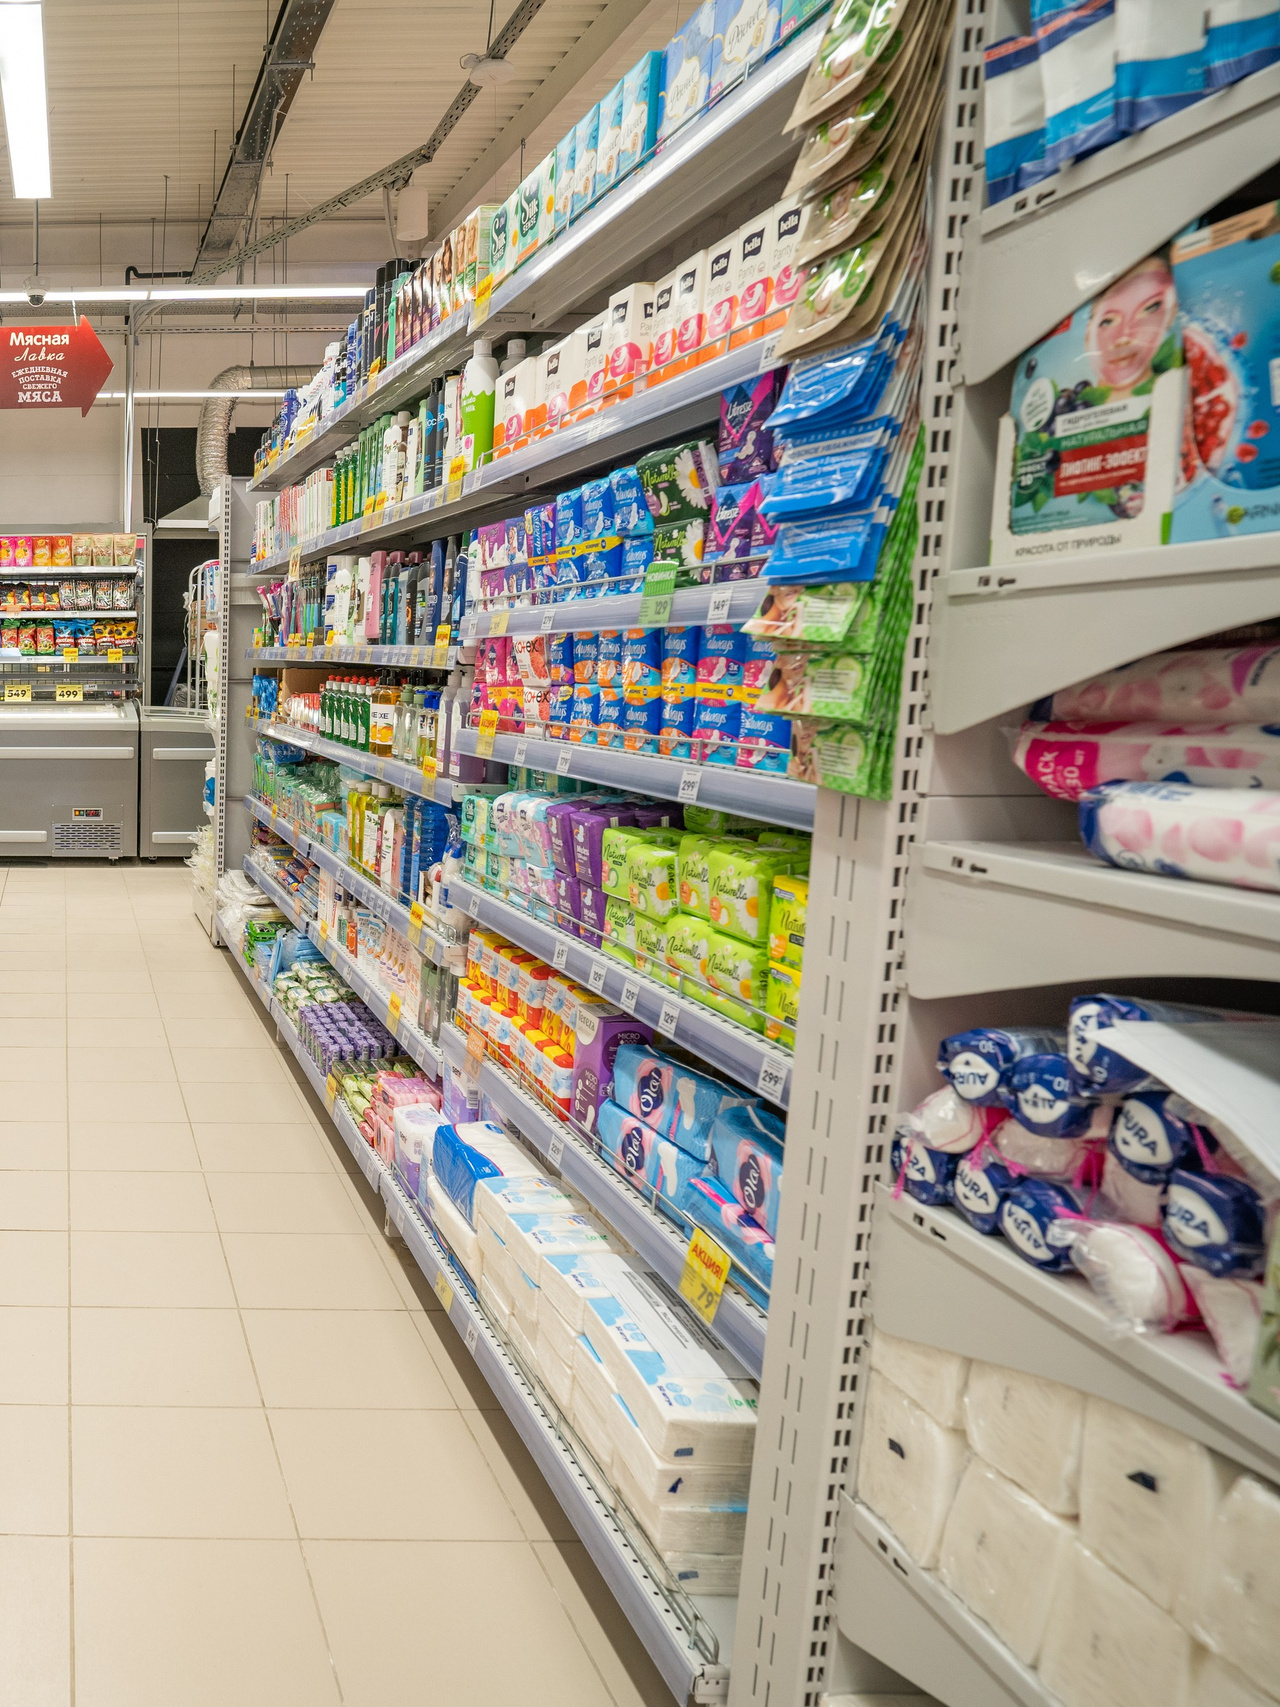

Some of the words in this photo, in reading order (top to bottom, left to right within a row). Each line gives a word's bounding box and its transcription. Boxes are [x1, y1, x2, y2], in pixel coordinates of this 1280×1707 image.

[520, 184, 539, 224] Silk
[780, 214, 799, 233] bella
[492, 216, 507, 257] Silk
[744, 235, 761, 254] bella
[712, 256, 728, 273] bella
[657, 292, 670, 308] bella
[9, 331, 70, 346] Мясная
[14, 347, 66, 362] Лавка
[11, 366, 68, 379] ЕЖЕДНЕВНАЯ
[19, 374, 62, 384] ПОСТАВКА
[17, 390, 62, 403] МЯСА
[654, 600, 668, 615] 129
[713, 598, 727, 612] 149
[664, 637, 687, 655] always
[706, 635, 733, 653] always
[7, 690, 27, 698] 549
[58, 690, 78, 699] 499
[626, 709, 648, 725] always
[683, 780, 697, 791] 299
[713, 876, 748, 901] Naturella
[556, 948, 564, 959] 69
[666, 936, 701, 961] Naturella
[592, 970, 602, 982] 129
[708, 958, 741, 983] Naturella
[624, 987, 635, 1000] 129
[578, 1009, 596, 1032] Tereza
[664, 1010, 676, 1024] 129
[617, 1032, 641, 1040] MICRO
[585, 1069, 598, 1084] MICRO
[761, 1070, 780, 1087] 299
[640, 1070, 662, 1112] Ola!
[625, 1128, 643, 1170] Ola!
[743, 1157, 762, 1208] Ola!
[691, 1243, 724, 1280] АКЦИЯ!
[697, 1283, 714, 1309] 79
